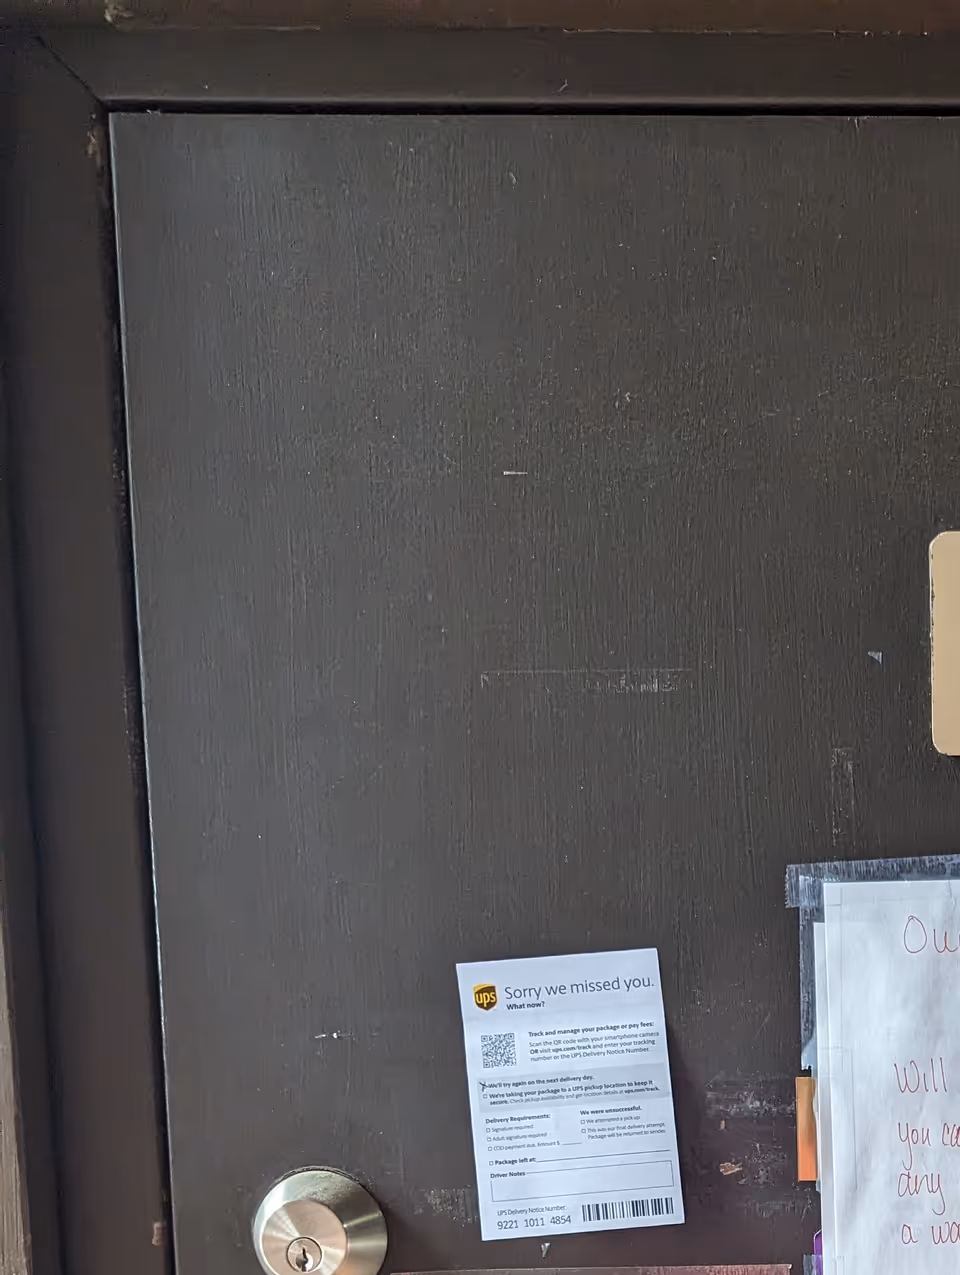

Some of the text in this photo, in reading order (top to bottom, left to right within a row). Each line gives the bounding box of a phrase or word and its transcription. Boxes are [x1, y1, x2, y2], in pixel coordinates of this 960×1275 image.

[475, 990, 496, 1007] ups
[504, 976, 654, 1000] Sorry we missed you.
[894, 1056, 947, 1093] Will
[897, 1170, 946, 1216] any
[496, 1214, 571, 1230] 9221 1011 4854
[901, 1224, 918, 1244] a
